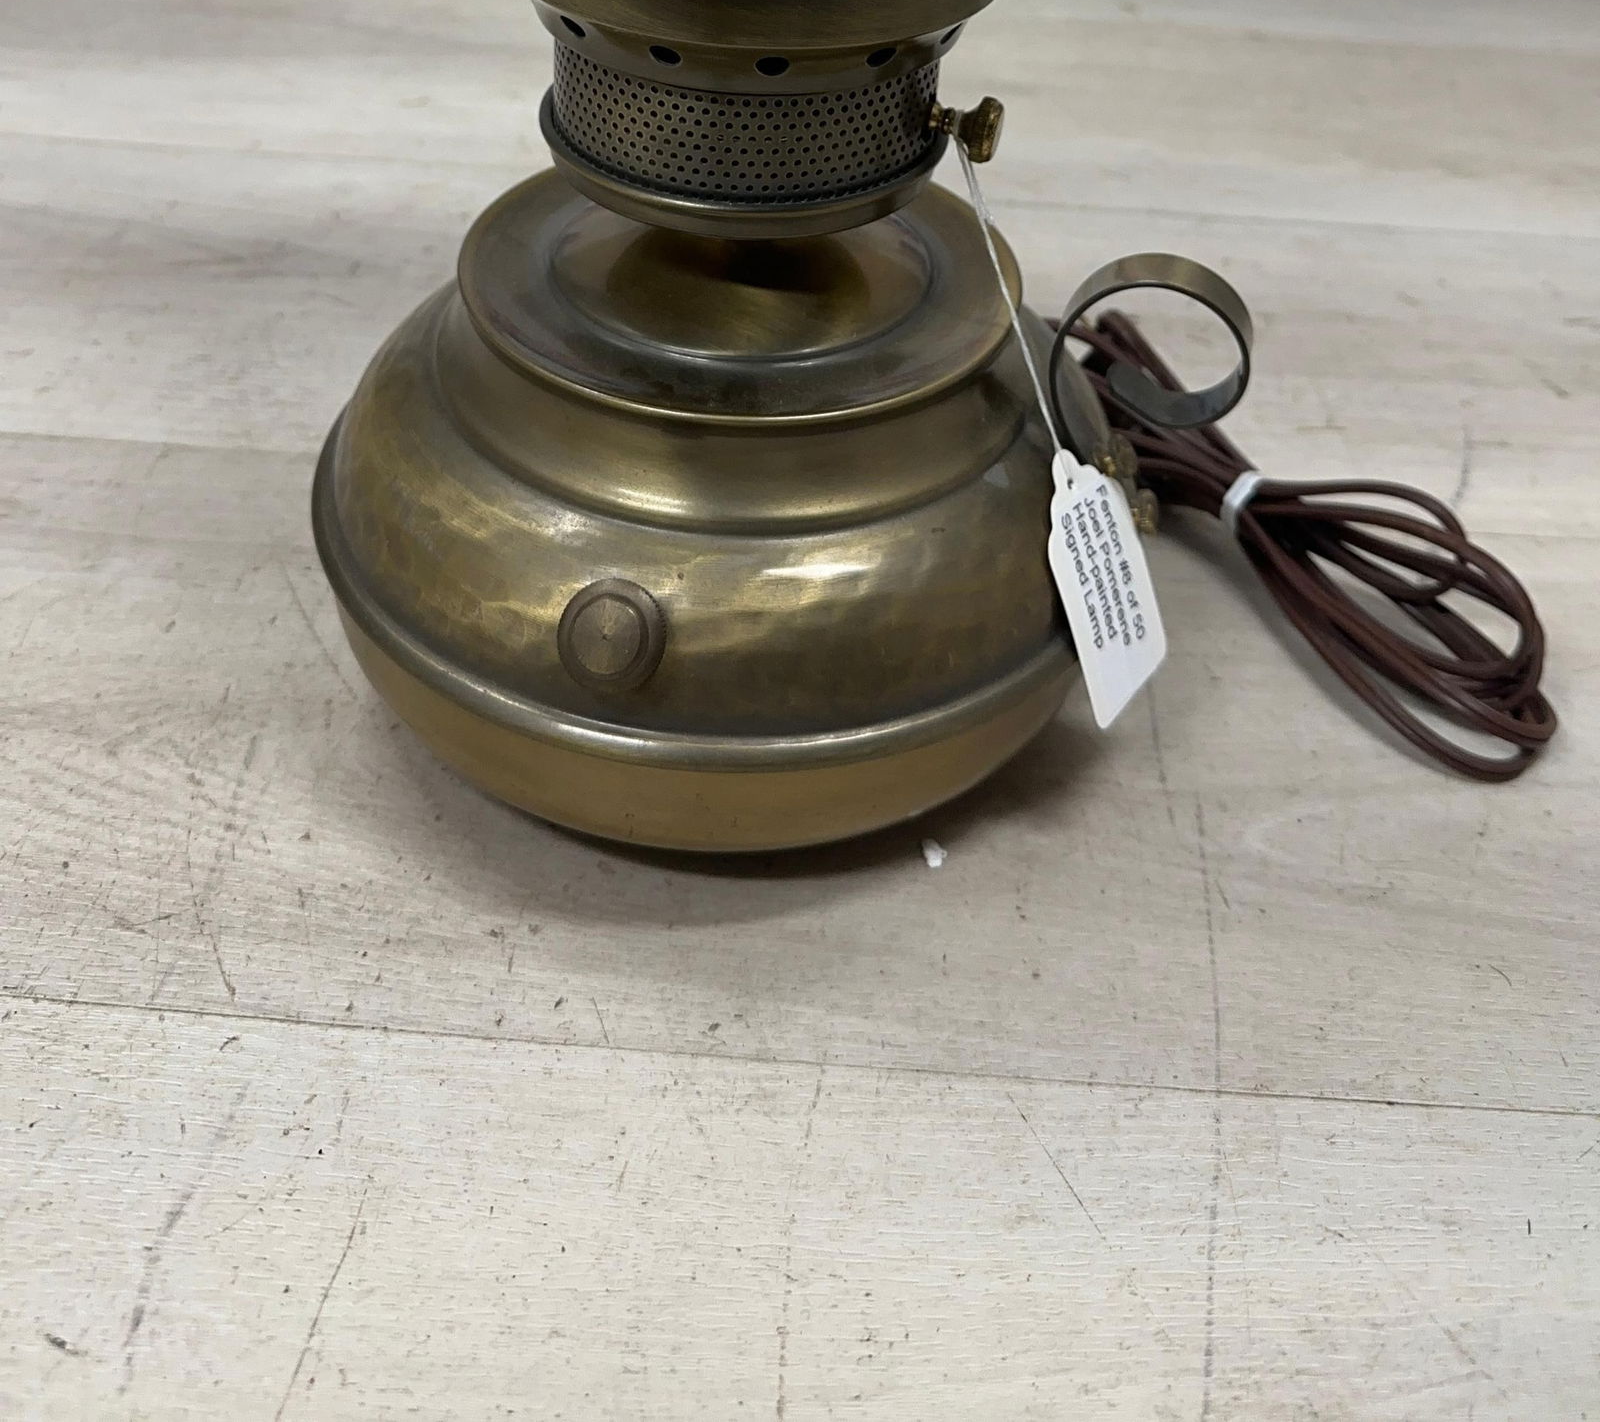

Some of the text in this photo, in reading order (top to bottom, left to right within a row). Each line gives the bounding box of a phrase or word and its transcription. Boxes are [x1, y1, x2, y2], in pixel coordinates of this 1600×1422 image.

[1073, 502, 1118, 640] Hand-painted
[1096, 484, 1123, 555] Fenton
[1061, 512, 1104, 649] Signed Lamp
[1084, 497, 1132, 647] Joel Pomerene
[1127, 590, 1140, 609] of
[1133, 613, 1146, 640] 50
